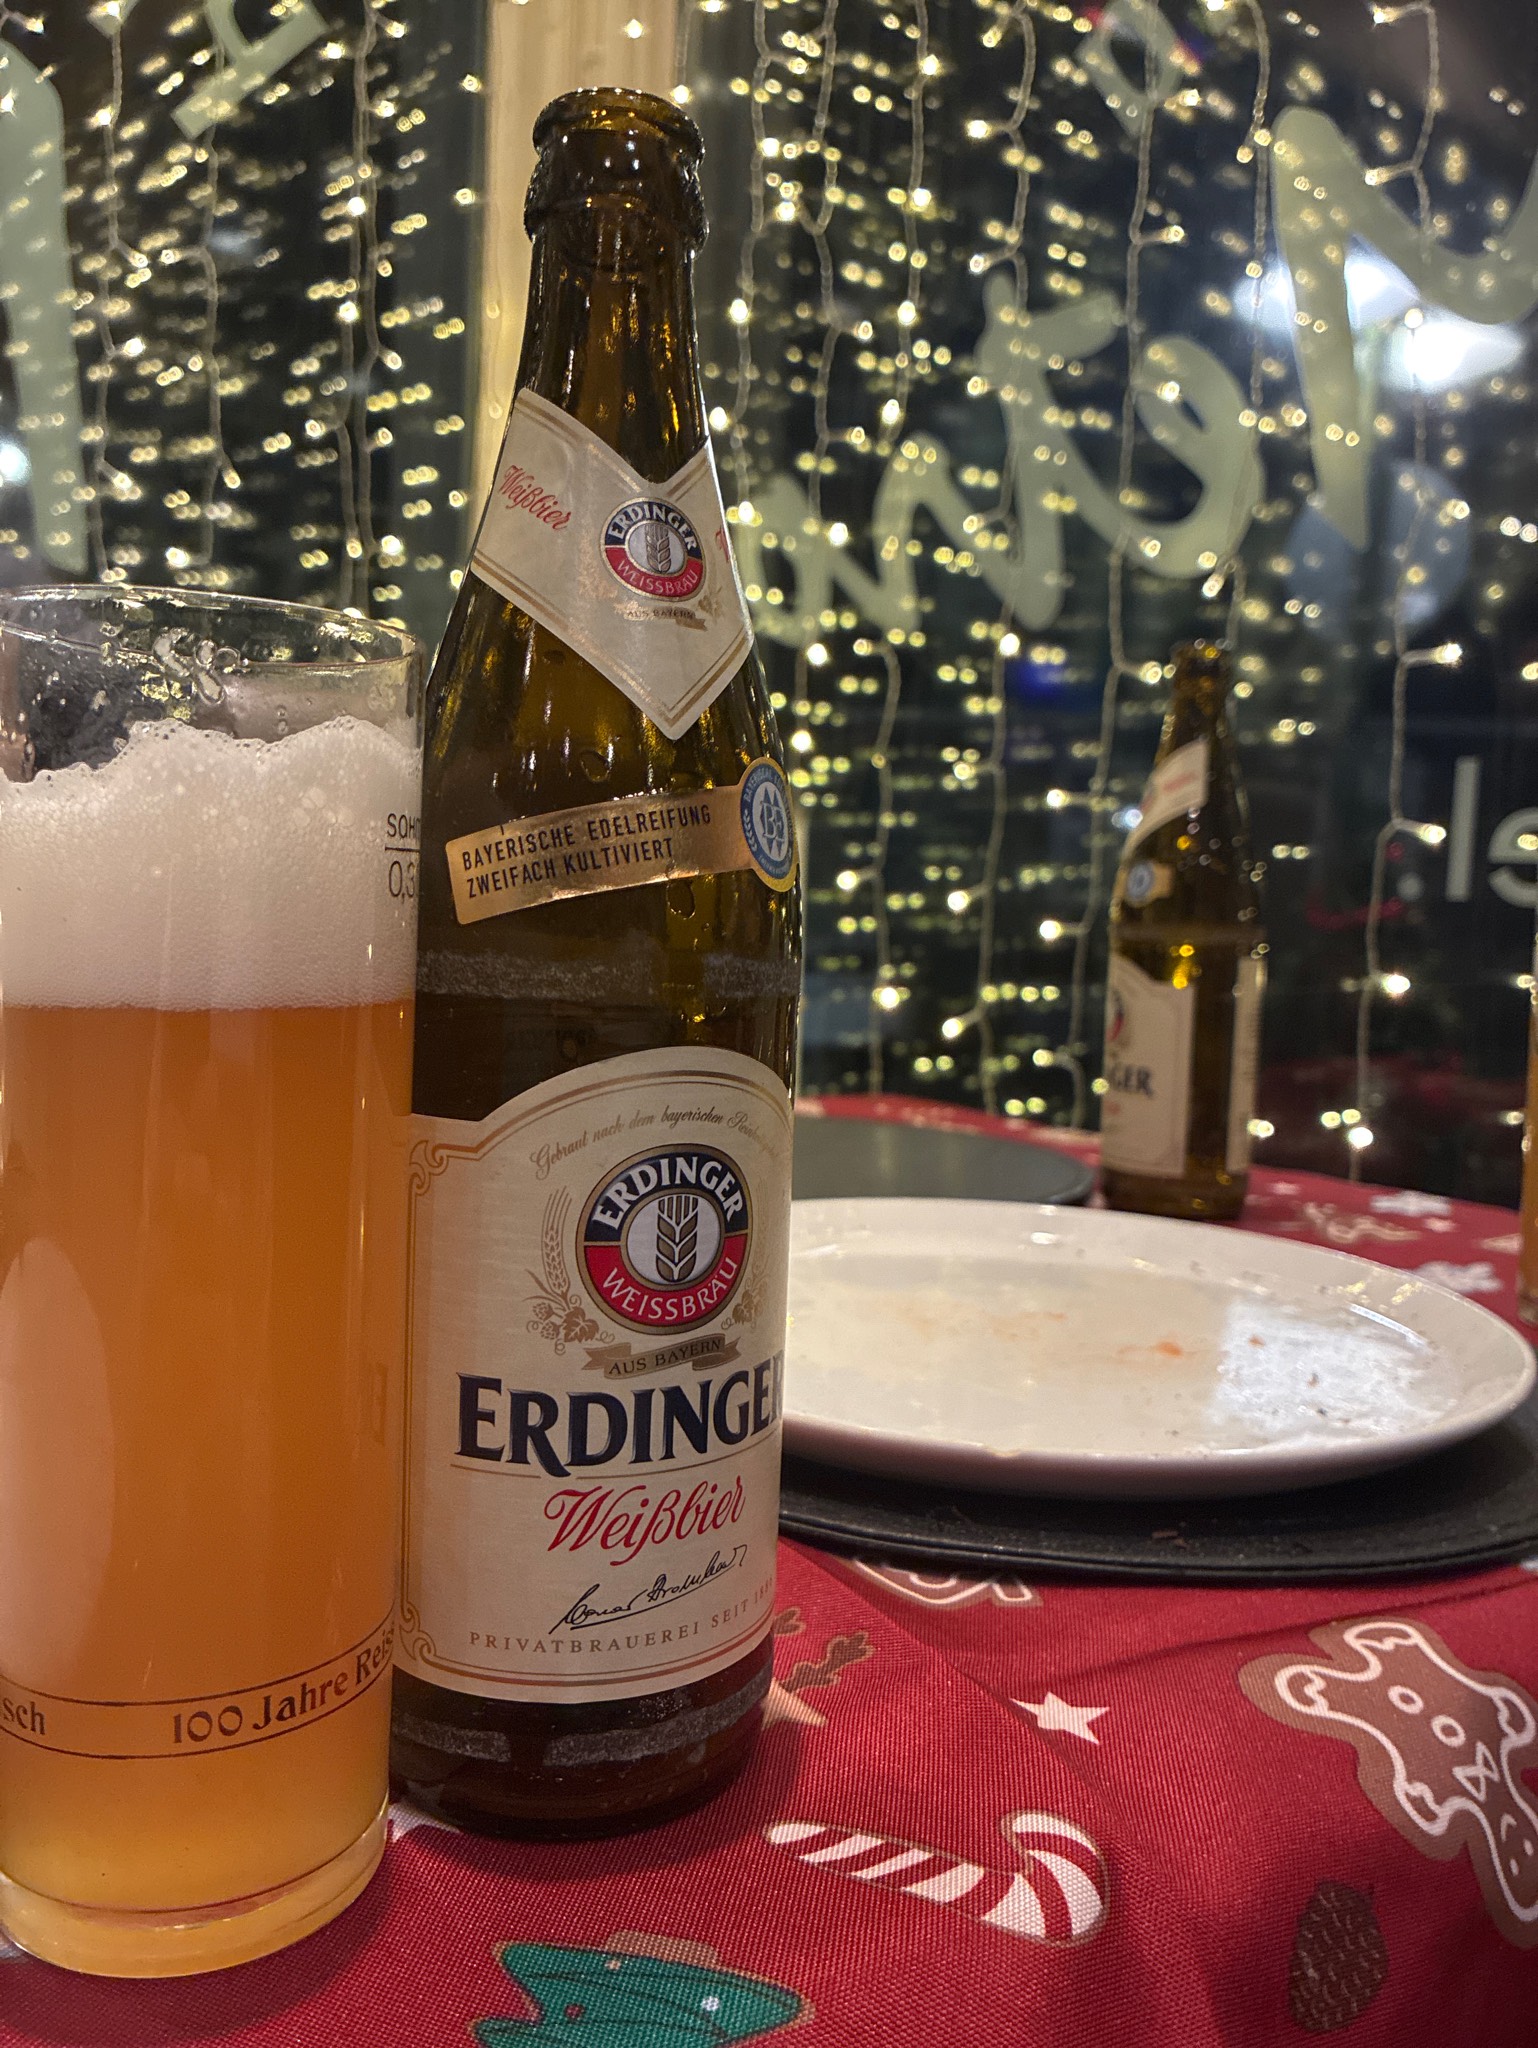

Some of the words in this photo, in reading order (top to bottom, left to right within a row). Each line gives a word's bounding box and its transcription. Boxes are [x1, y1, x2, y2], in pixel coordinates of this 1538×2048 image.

[499, 465, 572, 530] Weißbier
[609, 502, 699, 551] ERDINGER
[462, 823, 576, 872] BAYERISCHE
[588, 804, 712, 843] EDELREIFUNG
[467, 858, 556, 899] ZWEIFACH
[565, 837, 674, 877] KULTIVIERT
[530, 1132, 589, 1181] Gebraut
[592, 1119, 625, 1145] nach
[628, 1110, 656, 1130] dem
[660, 1105, 724, 1130] bayerischen
[592, 1155, 743, 1231] ERDINGER
[602, 1256, 738, 1320] WEISSBRÄU
[608, 1357, 647, 1376] AUS
[655, 1338, 722, 1368] BAYERN
[454, 1348, 784, 1478] ERDINGER
[544, 1475, 746, 1567] Weißbier
[469, 1622, 700, 1655] PRIVATBRAUEREI
[710, 1598, 751, 1629] SEIT
[173, 1705, 244, 1744] 100
[252, 1671, 349, 1731] Jahre
